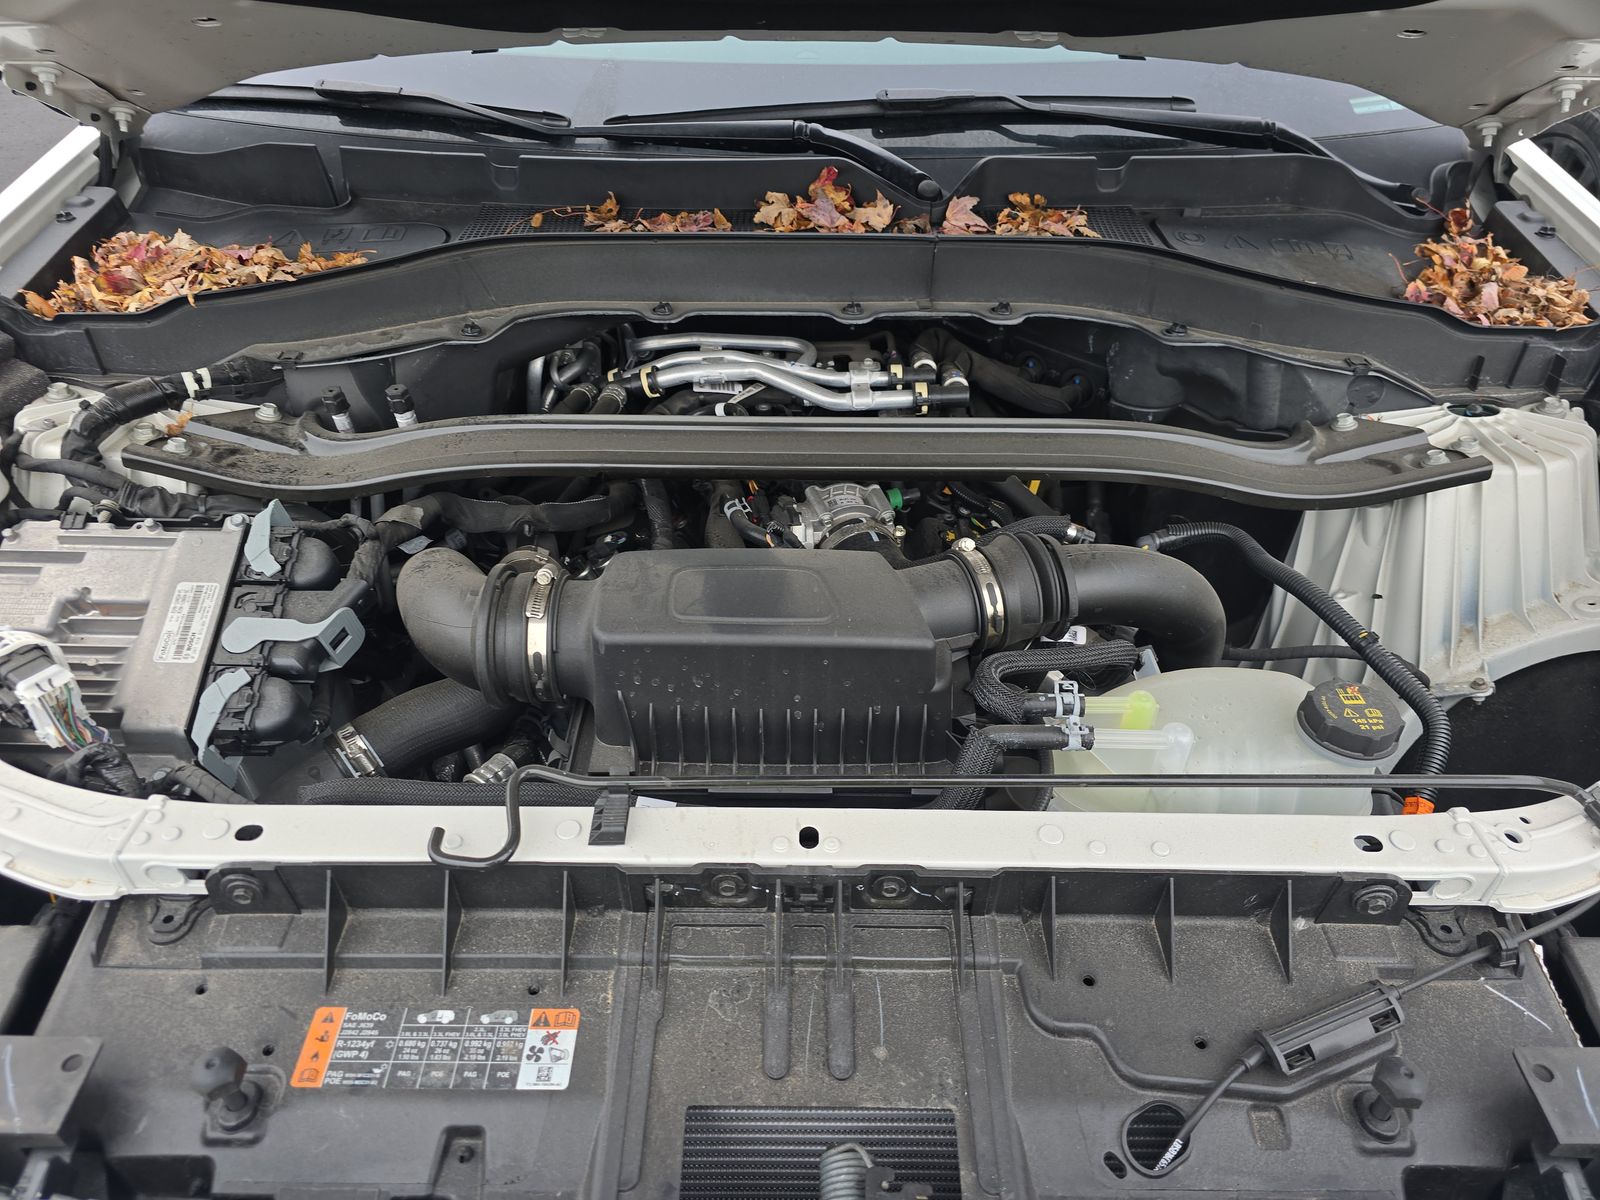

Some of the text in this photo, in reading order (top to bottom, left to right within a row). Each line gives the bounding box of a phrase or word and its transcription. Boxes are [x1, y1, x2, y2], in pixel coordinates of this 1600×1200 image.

[344, 1012, 387, 1021] FoMoCo
[336, 1040, 376, 1049] R-1234yf
[417, 1040, 427, 1048] kg
[448, 1040, 458, 1049] kg
[483, 1040, 492, 1048] kg
[332, 1050, 369, 1060] (GWP 4)
[326, 1070, 344, 1078] PAG
[324, 1077, 342, 1085] POE
